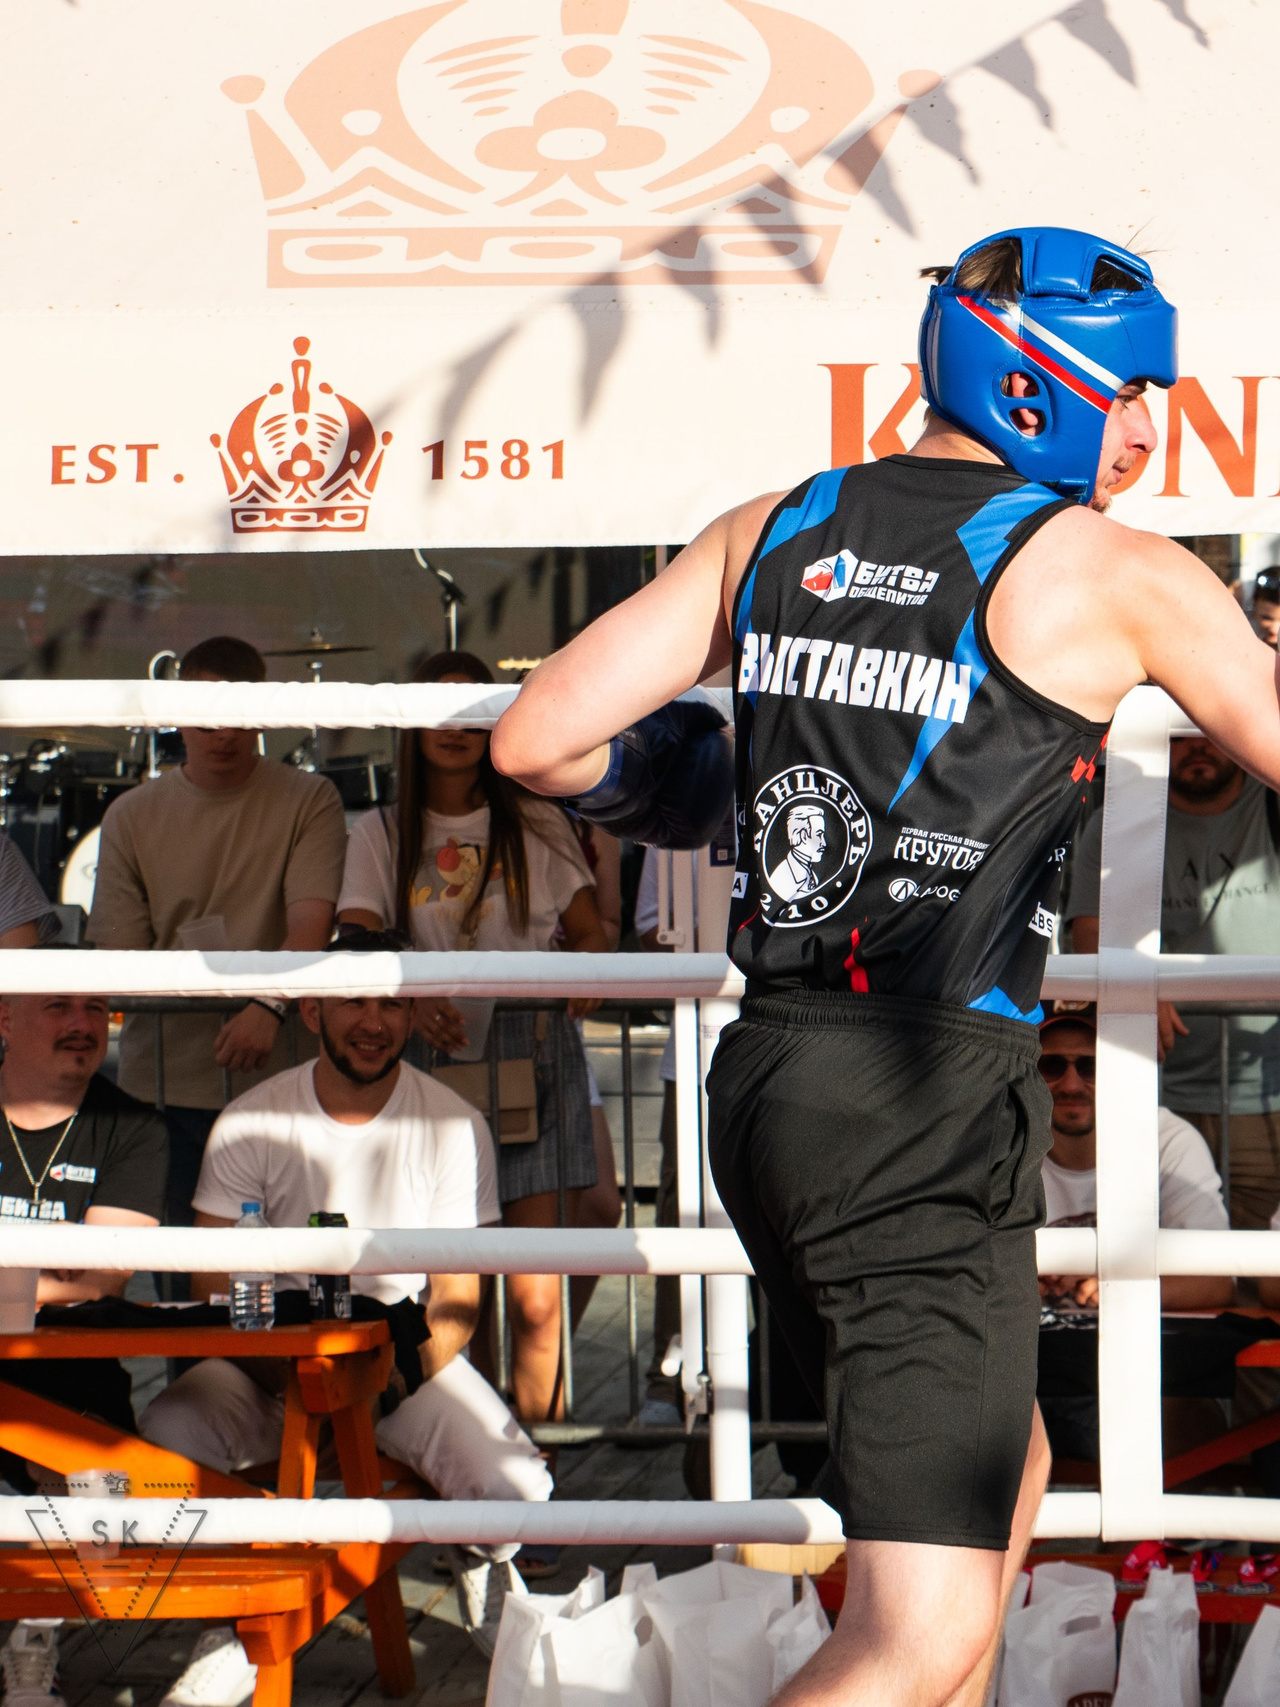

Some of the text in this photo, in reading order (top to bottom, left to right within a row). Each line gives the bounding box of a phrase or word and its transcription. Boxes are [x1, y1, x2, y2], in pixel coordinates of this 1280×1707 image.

[50, 438, 566, 486] EST. 1581
[848, 585, 929, 606] ОБЩЕПИТОВ
[854, 561, 940, 593] БИТВА
[737, 632, 972, 724] ВЫСТАВКИН
[893, 835, 986, 872] КРУТОЯ
